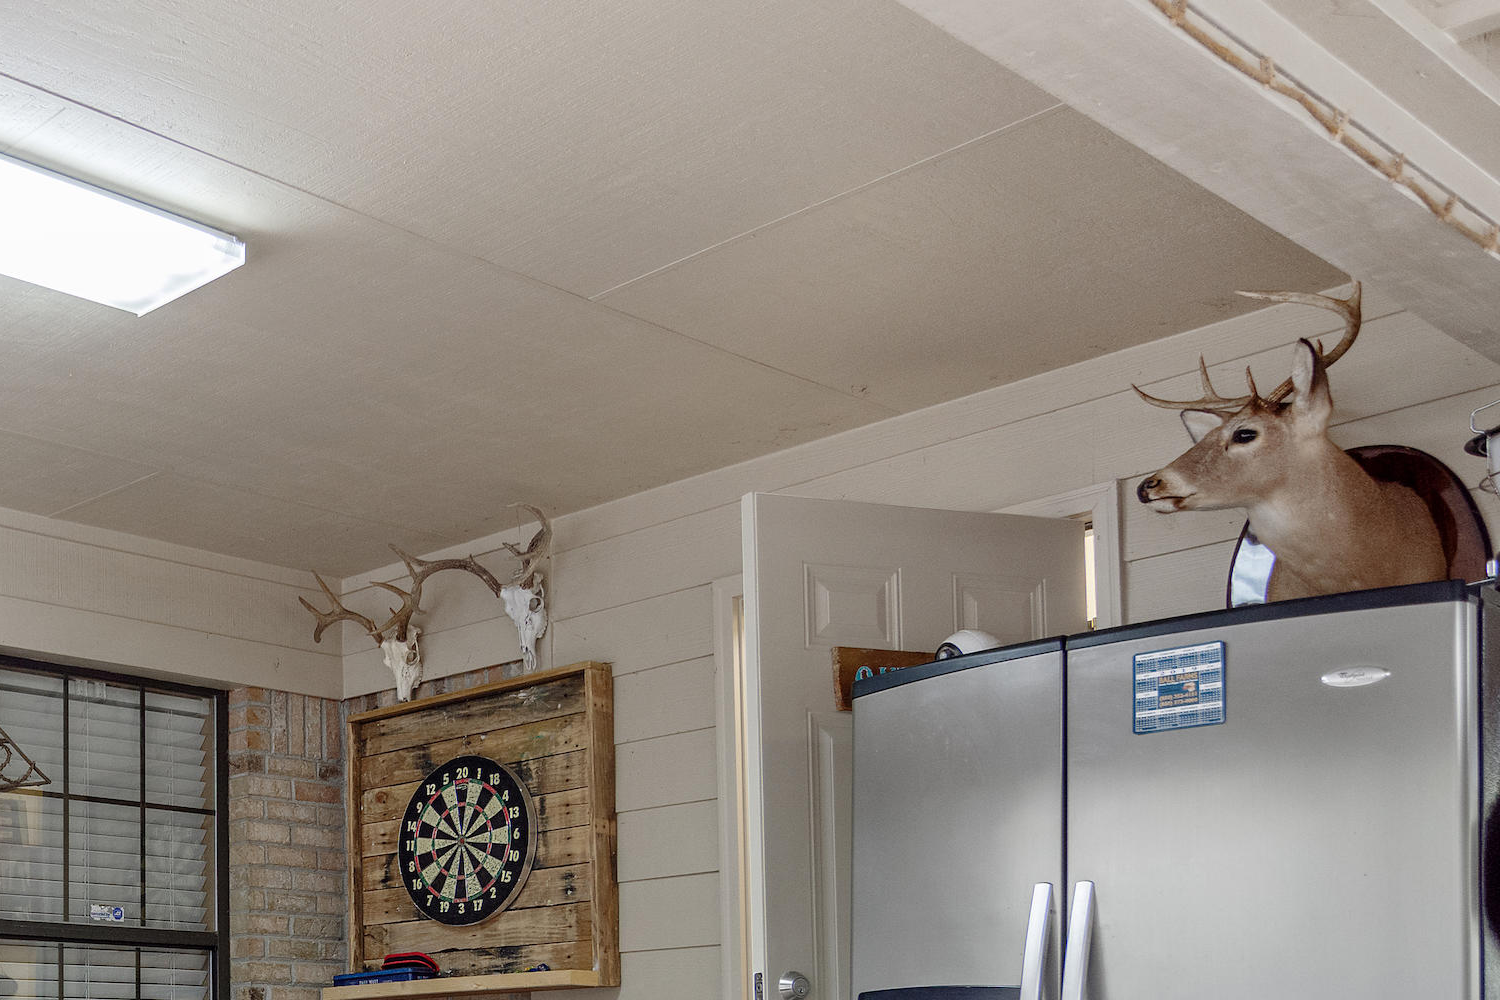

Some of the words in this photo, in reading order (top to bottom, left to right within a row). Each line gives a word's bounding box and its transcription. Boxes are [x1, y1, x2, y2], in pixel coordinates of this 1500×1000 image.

[456, 767, 469, 778] 20
[477, 768, 482, 779] 1
[442, 773, 450, 785] 5
[490, 773, 500, 786] 18
[426, 784, 436, 796] 12
[502, 790, 510, 802] 4
[416, 802, 423, 813] 9
[509, 807, 520, 818] 13
[407, 821, 417, 832] 14
[513, 828, 520, 840] 6
[406, 840, 414, 851] 11
[509, 850, 520, 862] 10
[408, 861, 416, 872] 8
[501, 871, 512, 883] 15
[412, 879, 422, 890] 16
[490, 887, 497, 899] 2
[426, 895, 434, 906] 7
[473, 900, 484, 912] 17
[440, 901, 450, 913] 19
[458, 903, 465, 914] 3
